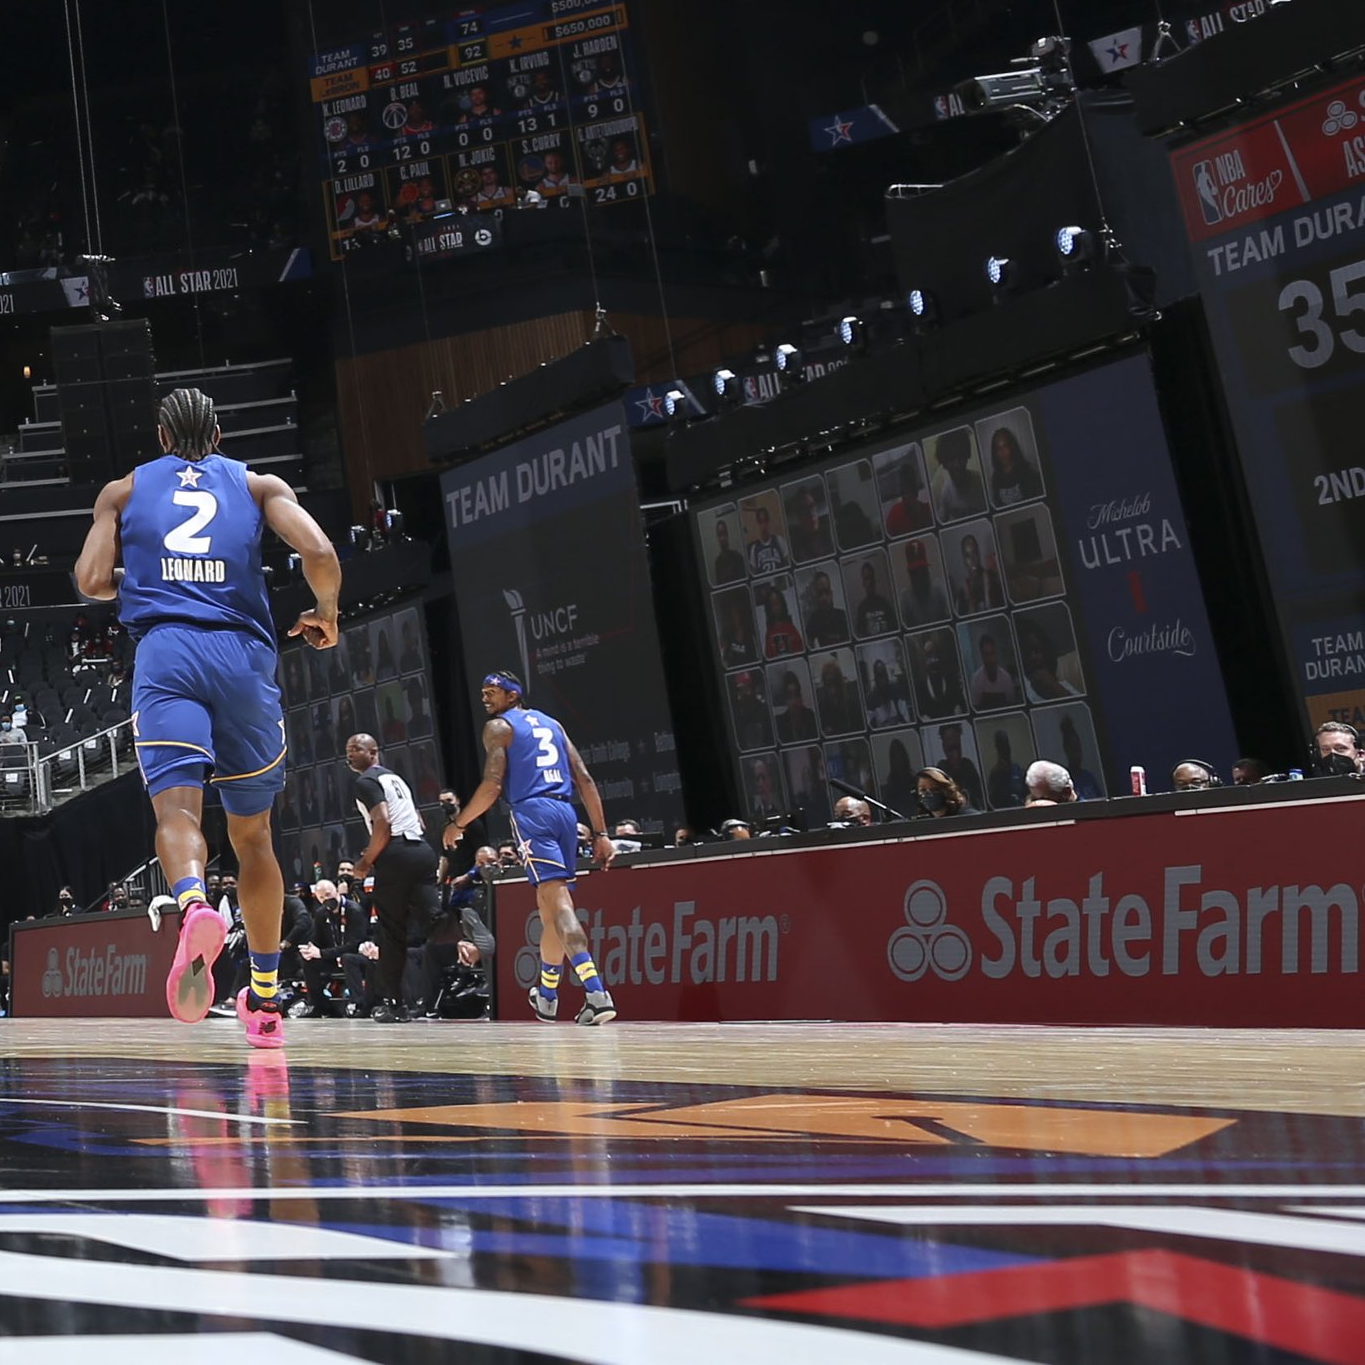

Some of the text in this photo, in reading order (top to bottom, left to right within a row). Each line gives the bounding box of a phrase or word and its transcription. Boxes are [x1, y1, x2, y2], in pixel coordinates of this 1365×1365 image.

[397, 37, 414, 52] 35
[460, 22, 479, 34] 74
[555, 15, 611, 38] $650,000
[314, 57, 358, 76] DURANT
[321, 48, 351, 65] TEAM
[370, 43, 388, 58] 39
[464, 45, 482, 59] 92
[530, 132, 562, 152] CURRY
[1215, 149, 1246, 186] NBA
[1223, 176, 1277, 218] Cares
[1207, 226, 1285, 276] TEAM
[155, 268, 239, 296] ALL STAR 2021
[1278, 261, 1365, 369] 35
[446, 425, 622, 529] TEAM DURANT
[163, 490, 218, 554] 2
[1087, 491, 1150, 530] Michelob
[1078, 518, 1182, 569] ULTRA
[161, 557, 225, 583] LEONARD
[5, 585, 31, 607] 2021
[530, 604, 578, 640] UNCF
[1107, 618, 1196, 662] Courtside
[1311, 631, 1364, 656] TEAM
[532, 727, 559, 767] 3
[980, 864, 1359, 979] StateFarm
[64, 945, 147, 996] StateFarm
